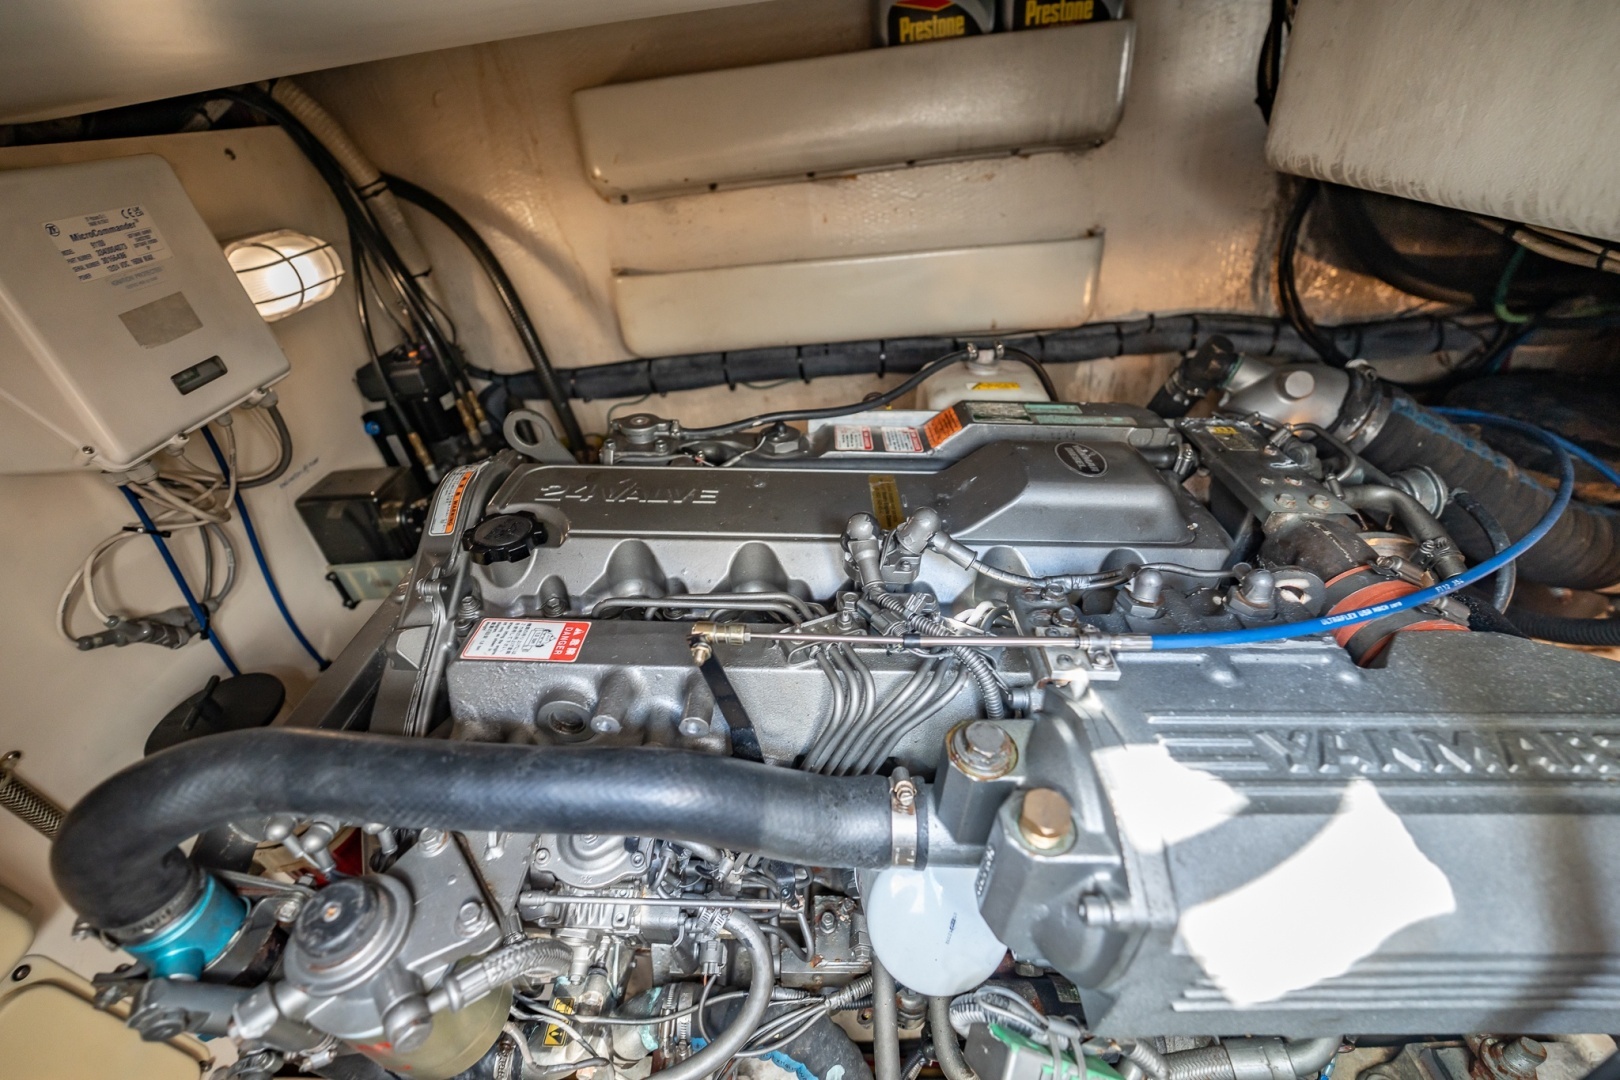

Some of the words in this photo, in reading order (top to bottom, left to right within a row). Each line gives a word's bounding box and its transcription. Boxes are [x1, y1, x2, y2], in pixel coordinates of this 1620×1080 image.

[1025, 0, 1093, 26] Prestone
[900, 15, 965, 43] Prestone
[69, 221, 137, 242] MicroCommander
[534, 484, 596, 503] 24
[600, 479, 720, 505] VALVE
[555, 627, 573, 655] DANGER
[1254, 728, 1592, 775] YANMAR
